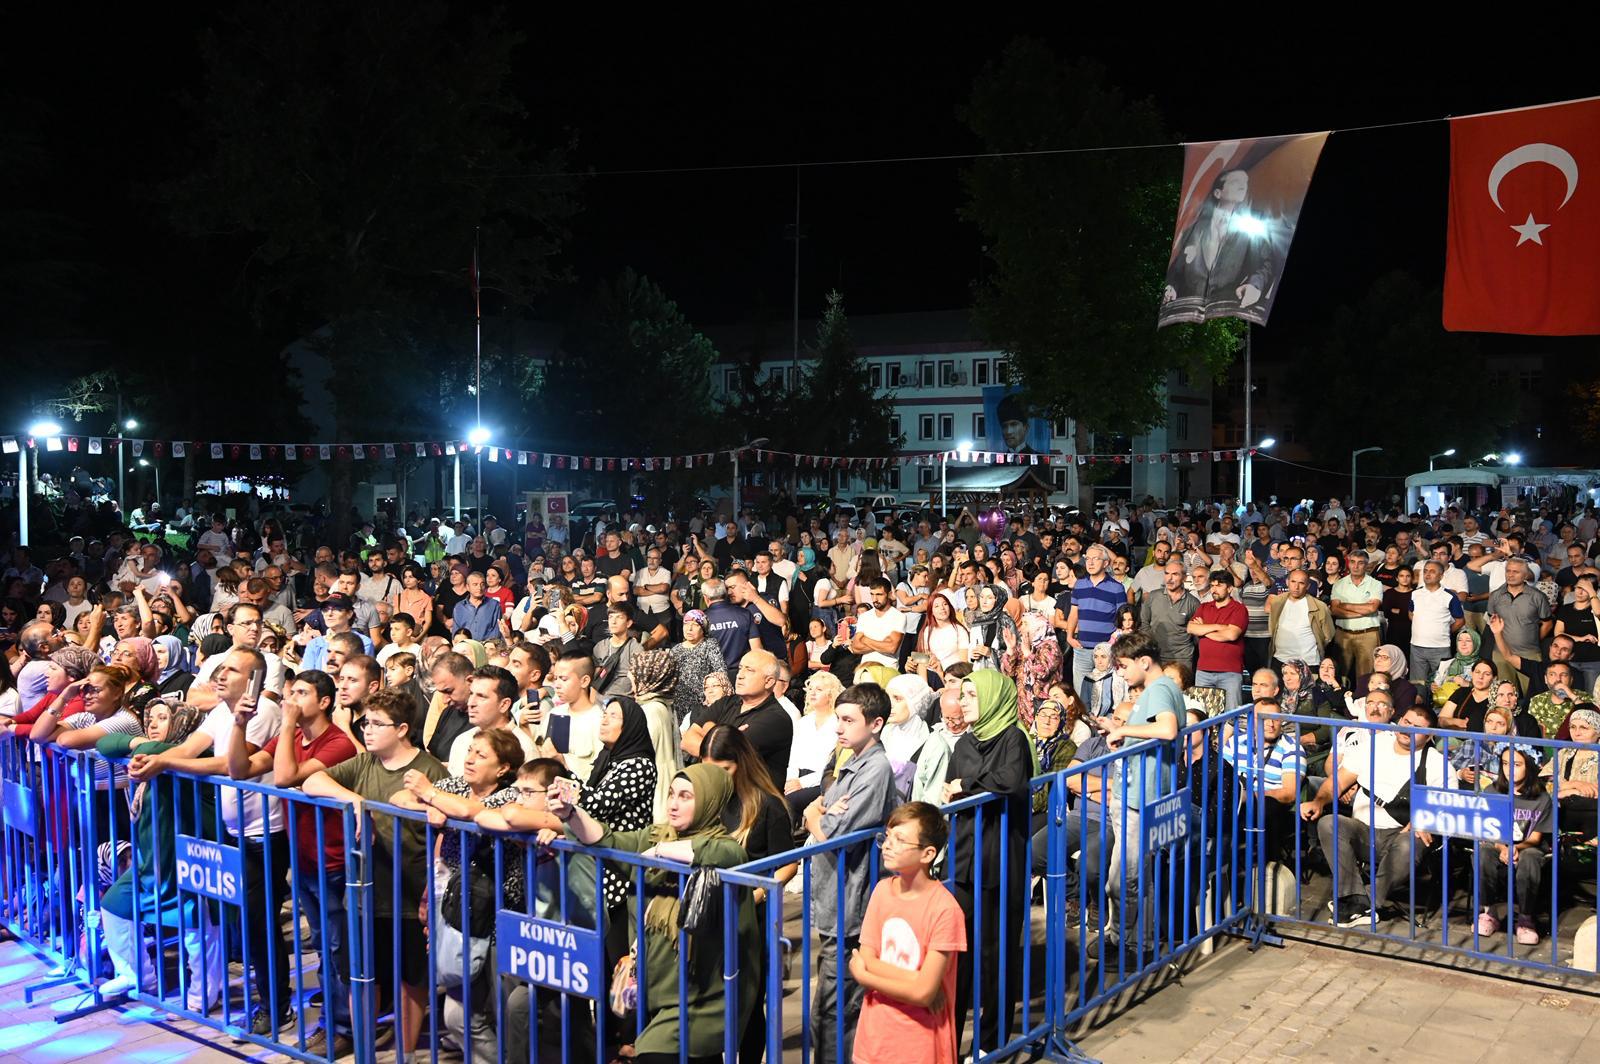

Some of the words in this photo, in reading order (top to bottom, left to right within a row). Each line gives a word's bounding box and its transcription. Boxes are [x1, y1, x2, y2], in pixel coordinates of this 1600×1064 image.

[709, 620, 739, 632] ABITA
[1154, 796, 1182, 819] KONYA
[1426, 789, 1491, 812] KONYA
[1149, 811, 1187, 850] POLİS
[1414, 808, 1502, 841] POLİS
[187, 841, 223, 864] KONYA
[520, 920, 578, 951] KONYA
[510, 945, 589, 994] POLİS
